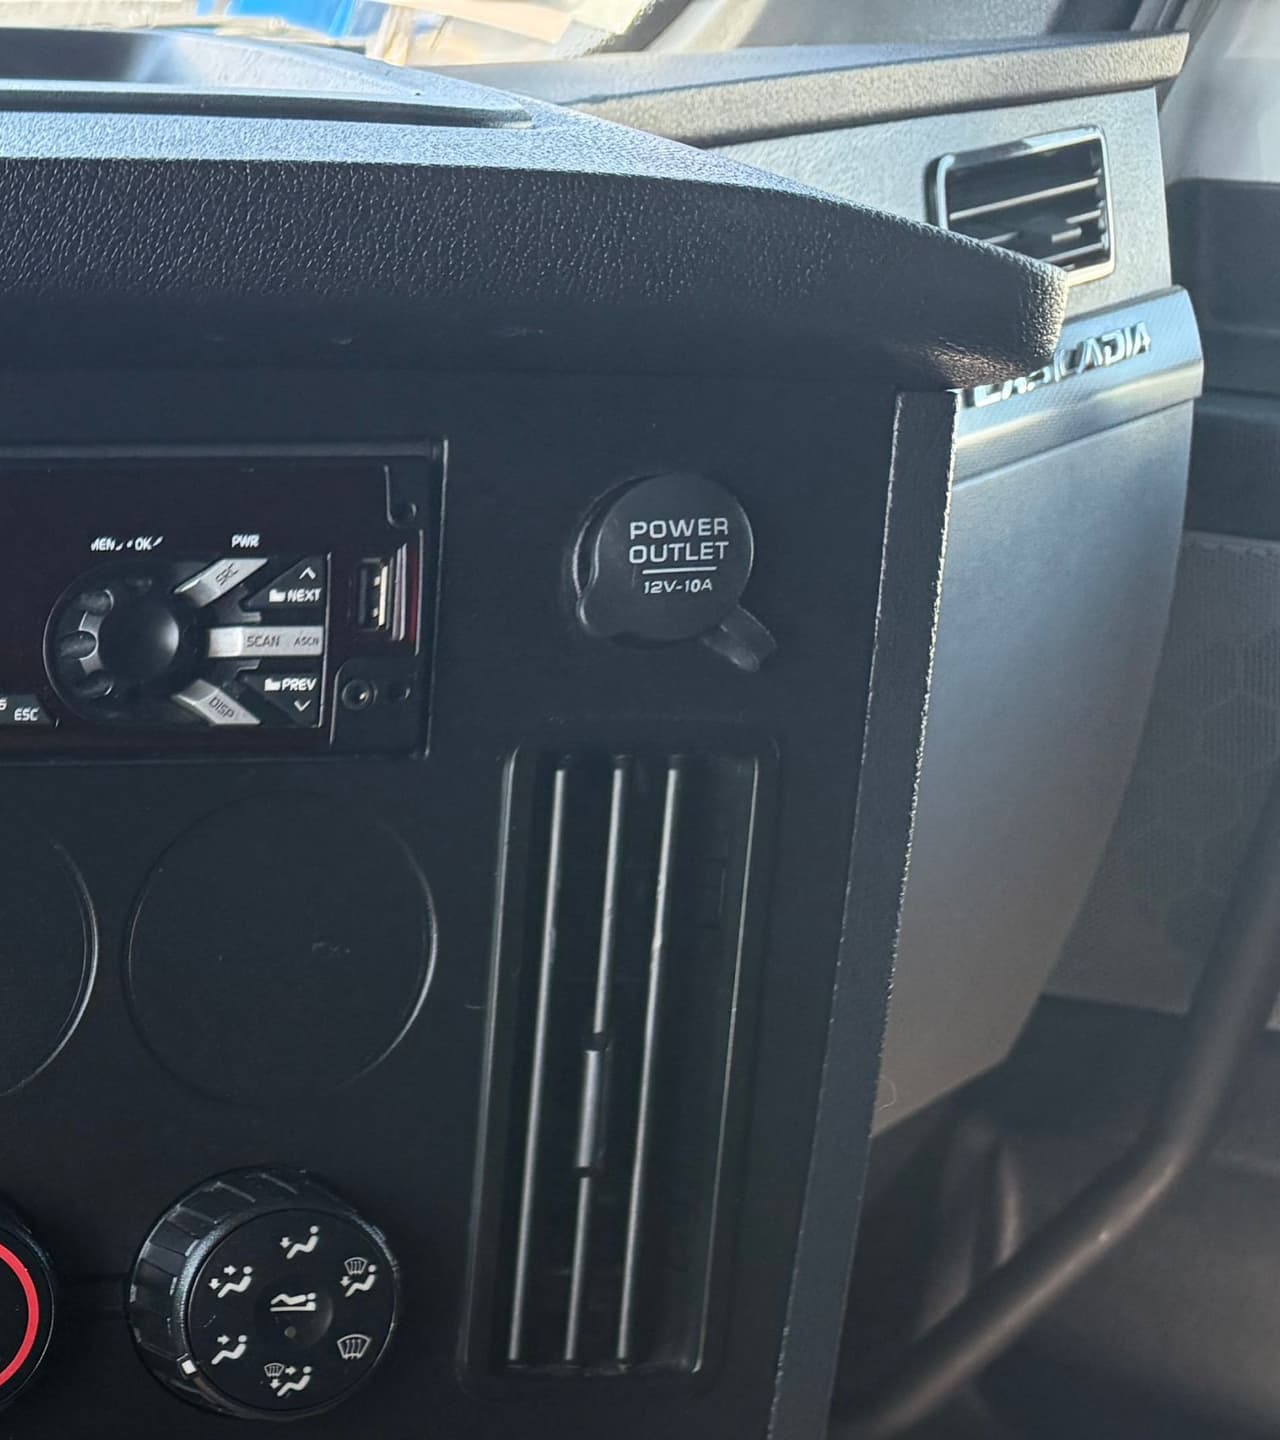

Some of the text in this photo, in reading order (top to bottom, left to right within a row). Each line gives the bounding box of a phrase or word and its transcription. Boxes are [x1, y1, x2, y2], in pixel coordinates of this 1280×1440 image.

[629, 518, 728, 540] POWER
[232, 534, 260, 548] PWR
[629, 541, 729, 564] OUTLET
[643, 578, 713, 594] 12V-10A
[287, 587, 321, 602] NEXT
[247, 635, 280, 647] SCAN
[282, 678, 317, 691] PREV
[14, 707, 40, 721] ESC
[208, 695, 235, 718] DISP
